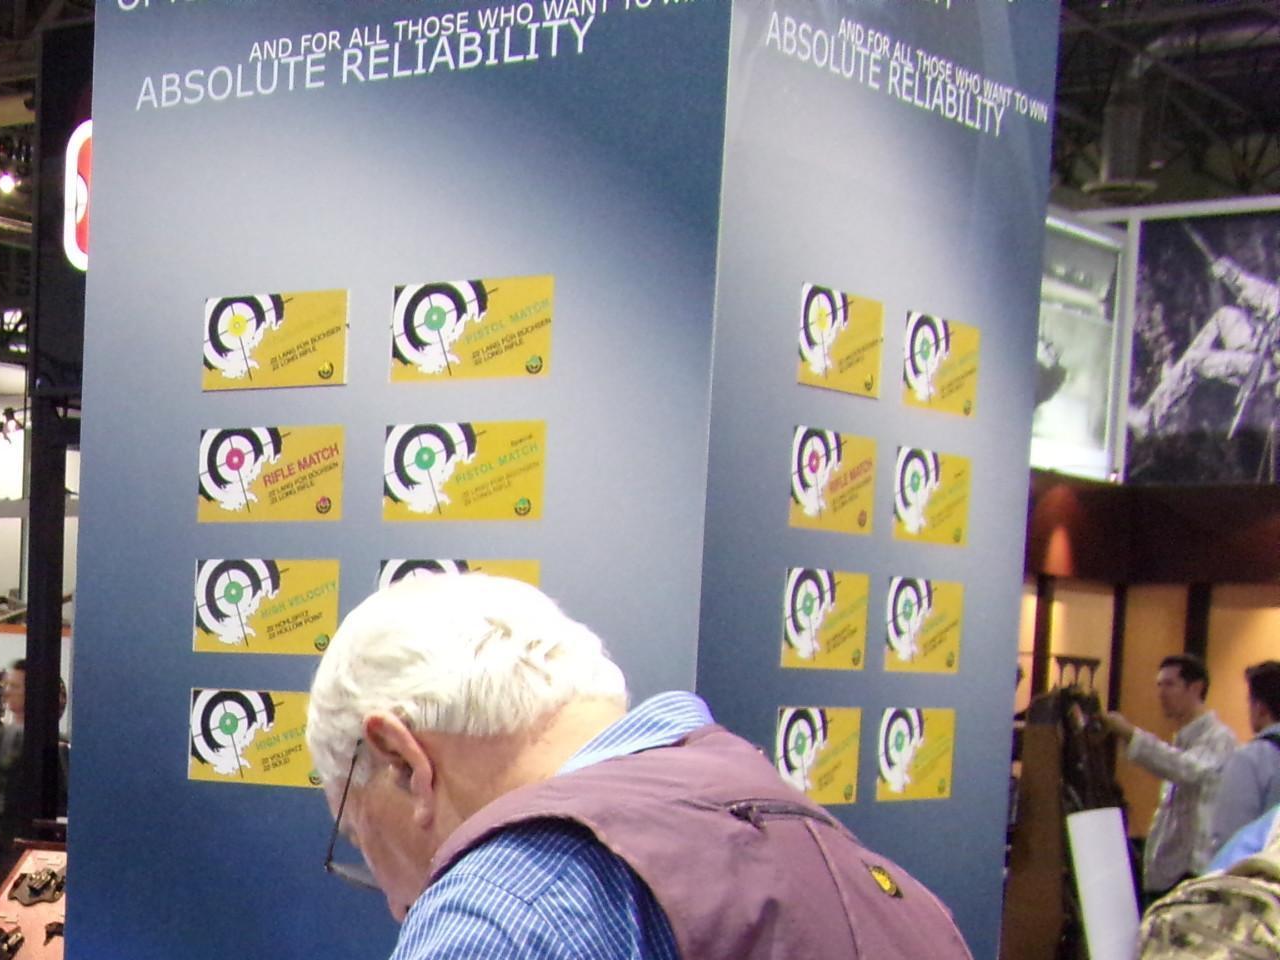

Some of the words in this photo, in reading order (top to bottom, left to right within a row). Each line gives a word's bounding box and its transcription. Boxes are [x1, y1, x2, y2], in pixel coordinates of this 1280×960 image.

[136, 53, 326, 110] ABSOLUTE
[342, 15, 595, 84] RELIABILITY
[249, 38, 293, 63] AND
[300, 31, 341, 55] FOR
[349, 24, 387, 48] ALL
[394, 12, 469, 42] THOSE
[478, 3, 533, 30] WHO
[766, 10, 880, 89] ABSOLUTE
[888, 61, 1005, 137] RELIABILITY
[838, 17, 864, 46] AND
[867, 29, 890, 56] FOR
[893, 40, 914, 67] ALL
[916, 49, 953, 84] THOSE
[955, 67, 980, 95] WHO
[983, 78, 1013, 106] WANT
[1014, 92, 1028, 115] TO
[1029, 100, 1048, 123] WIN
[263, 464, 296, 488] RIFLE
[297, 442, 340, 473] MATCH
